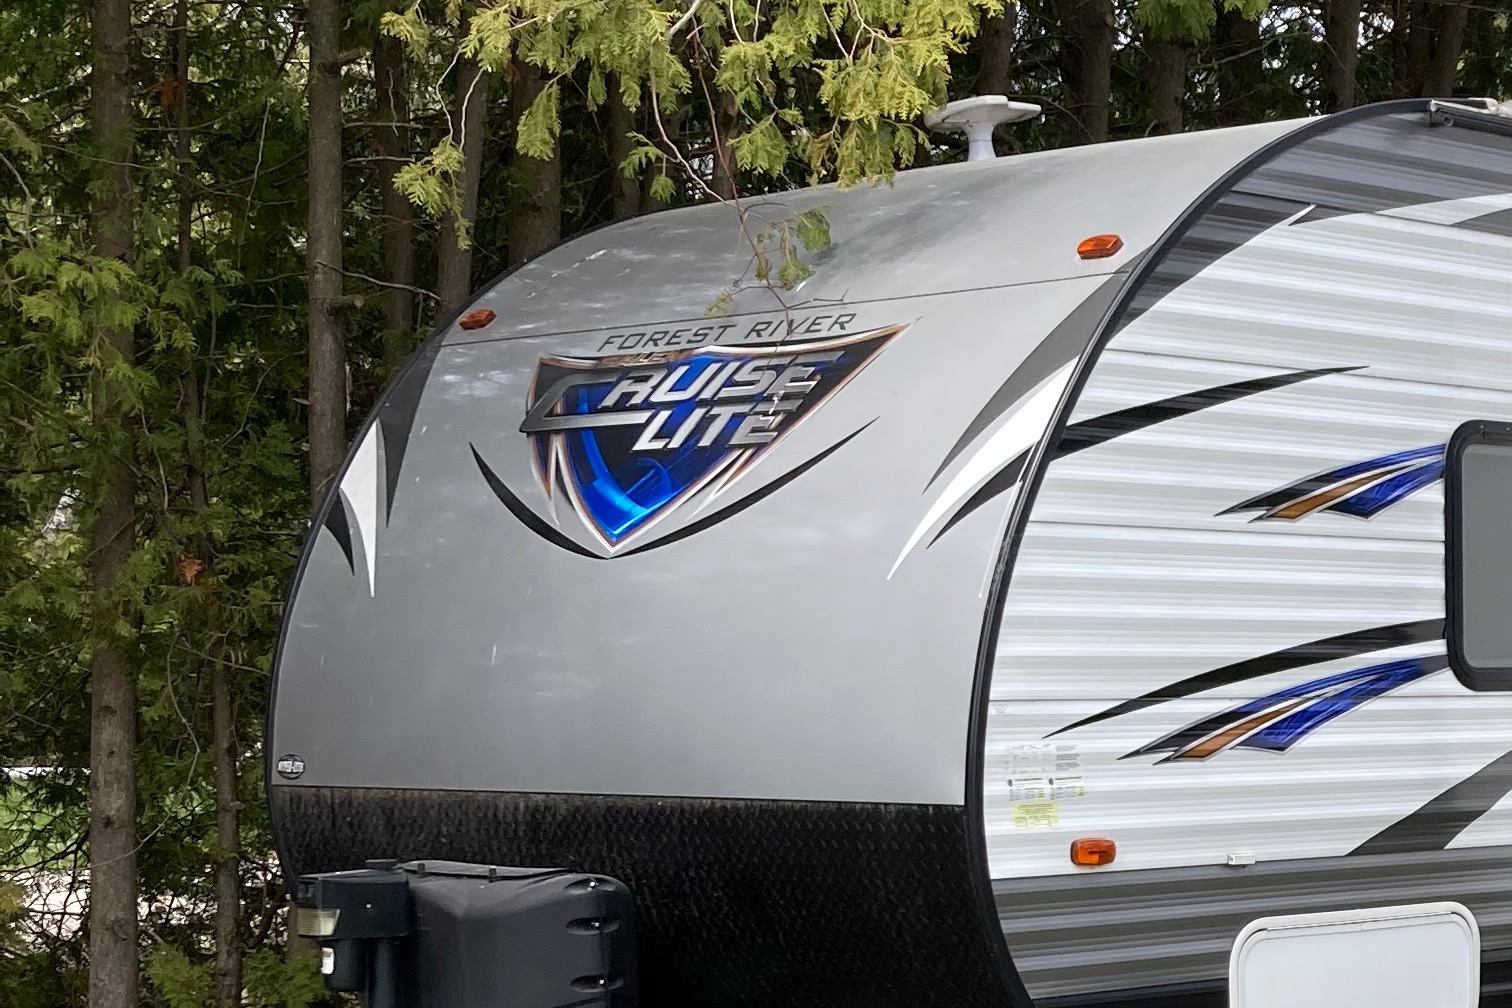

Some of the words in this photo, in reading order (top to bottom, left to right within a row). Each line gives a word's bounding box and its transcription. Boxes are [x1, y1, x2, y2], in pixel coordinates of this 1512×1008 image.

[597, 323, 737, 352] FOREST
[743, 312, 857, 340] RIVER
[519, 350, 845, 433] CRUISE
[632, 399, 803, 450] LITE
